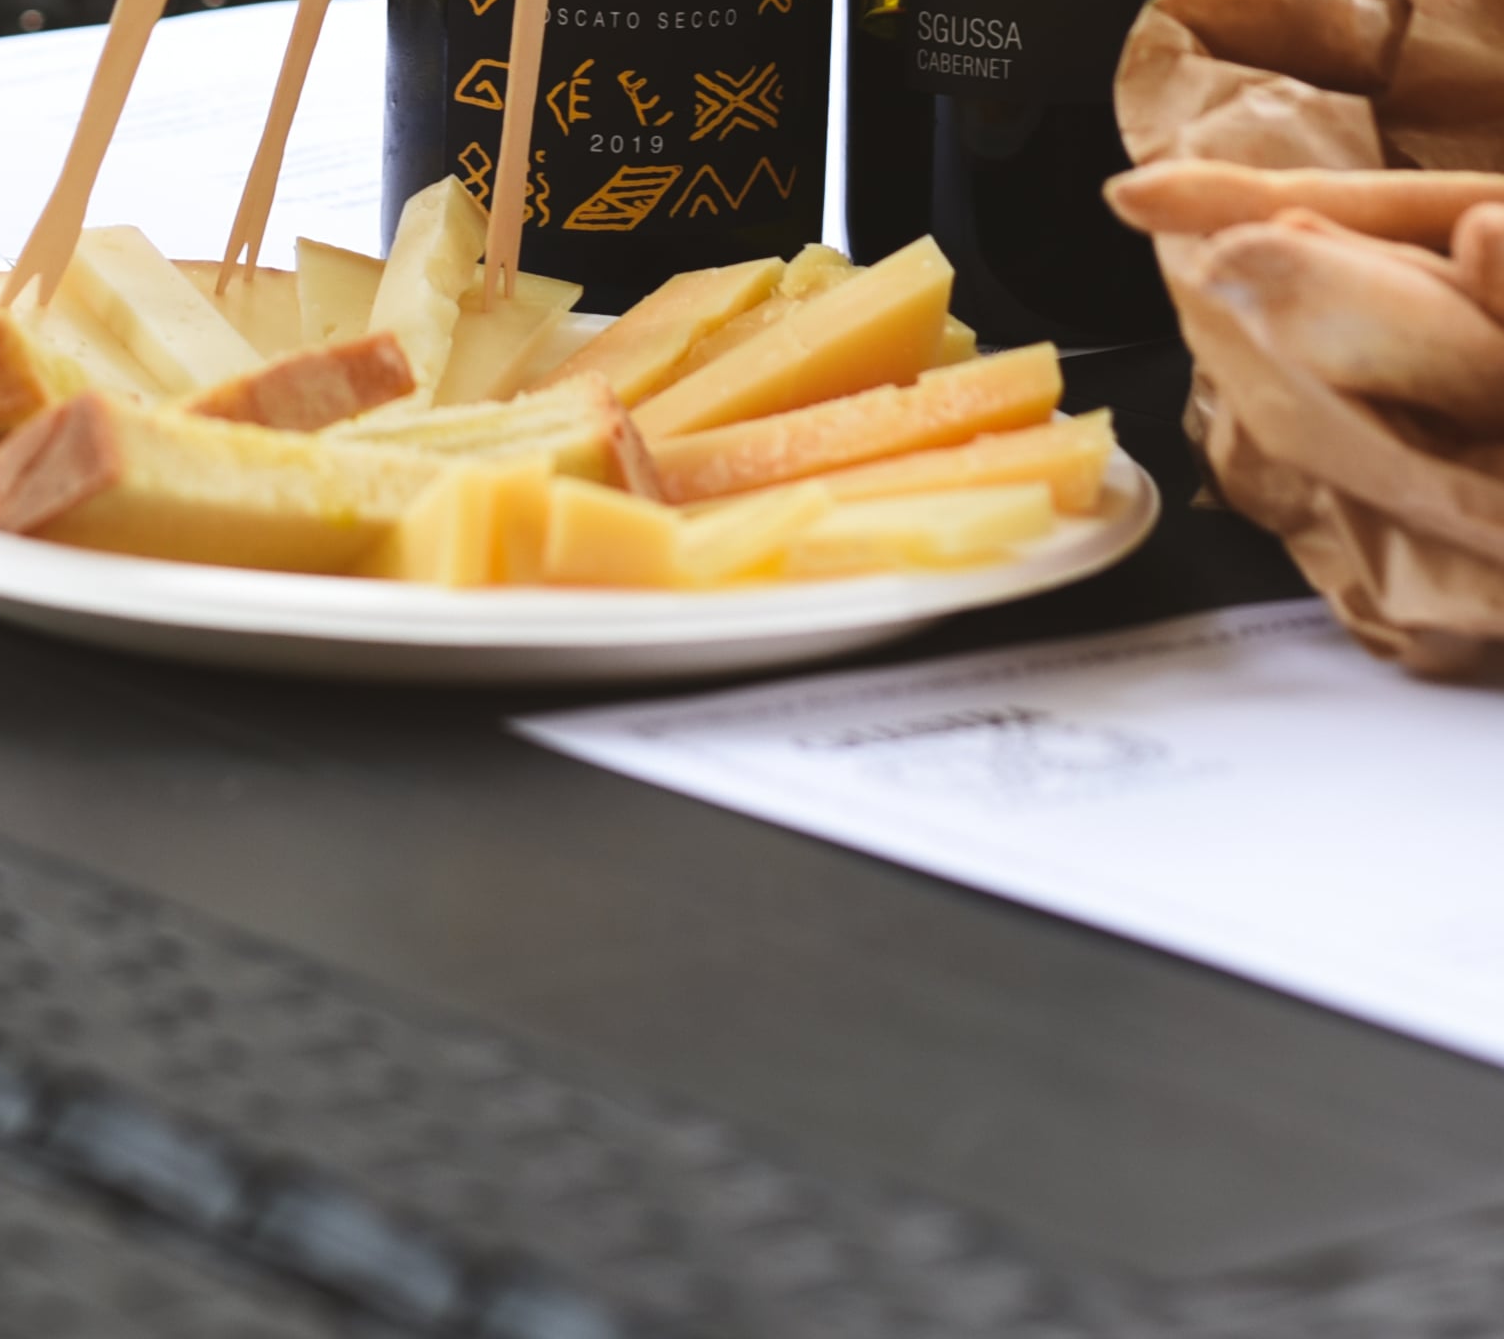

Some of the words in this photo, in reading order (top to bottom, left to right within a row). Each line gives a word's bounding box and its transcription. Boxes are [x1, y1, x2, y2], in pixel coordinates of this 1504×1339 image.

[656, 8, 738, 29] SECCO
[917, 10, 1023, 51] SGUSSA
[916, 48, 1014, 80] CABERNET
[589, 133, 664, 154] 2019
